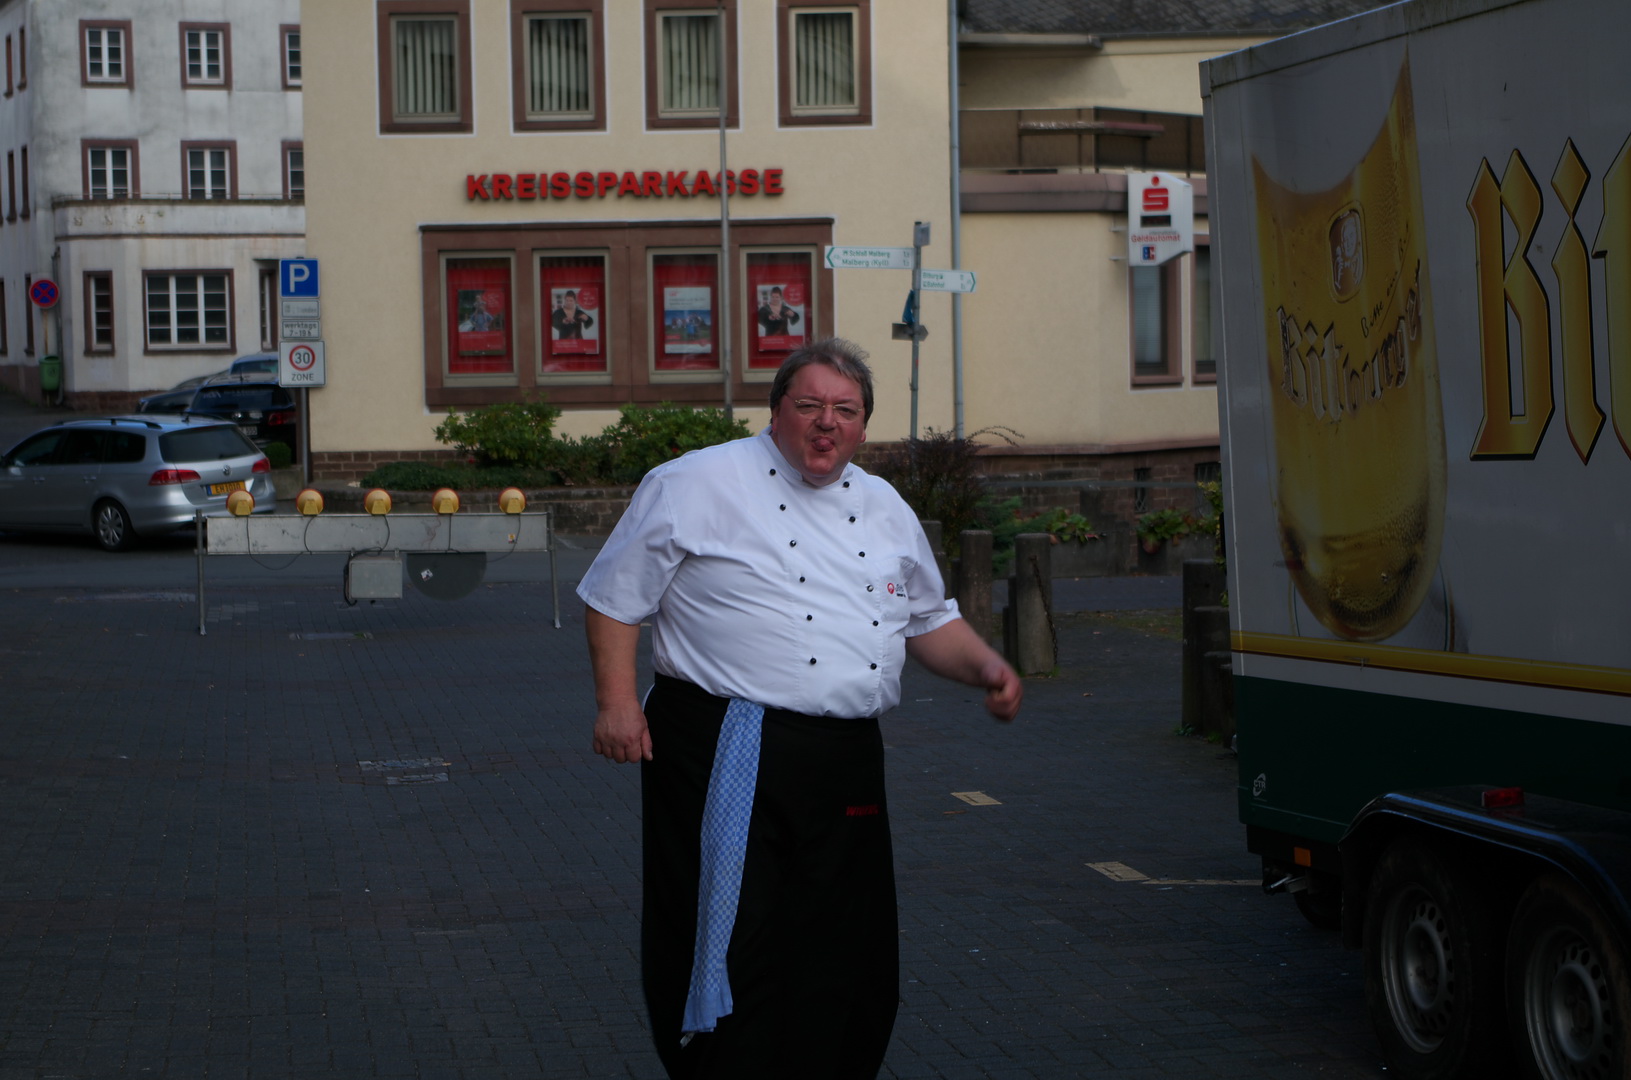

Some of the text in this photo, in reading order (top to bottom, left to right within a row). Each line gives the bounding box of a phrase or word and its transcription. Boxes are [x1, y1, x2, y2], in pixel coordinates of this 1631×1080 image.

[466, 168, 784, 200] KREISSPARKASSE
[1131, 234, 1180, 243] Geldautomat
[868, 250, 891, 258] Malberg
[842, 259, 870, 268] Malberg
[289, 263, 311, 293] P
[284, 321, 317, 330] werktags
[294, 352, 311, 365] 30
[291, 373, 315, 382] ZONE
